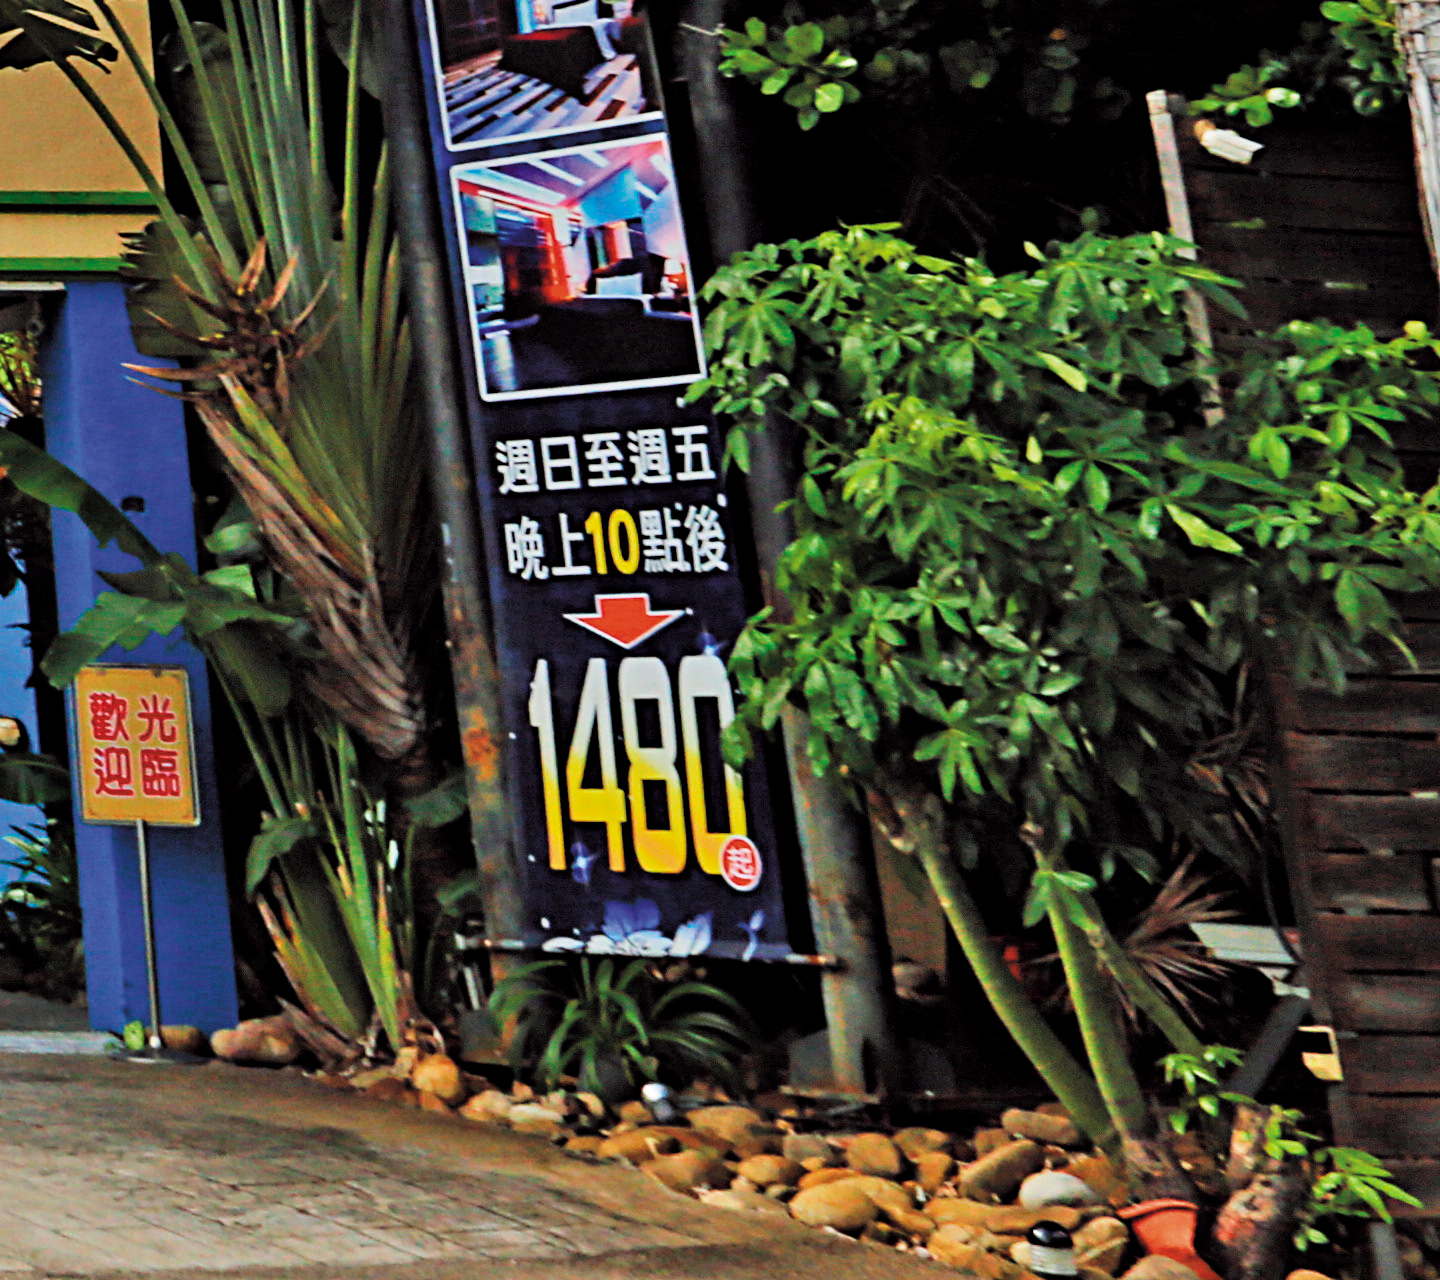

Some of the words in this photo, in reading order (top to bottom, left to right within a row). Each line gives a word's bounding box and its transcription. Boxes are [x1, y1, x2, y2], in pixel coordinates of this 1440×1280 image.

[495, 424, 717, 494] 週日至週五
[503, 504, 730, 580] 晚上10點後
[88, 691, 135, 797] 歡迎
[137, 693, 181, 798] 光臨
[528, 654, 748, 876] 1480
[725, 844, 757, 881] 起
